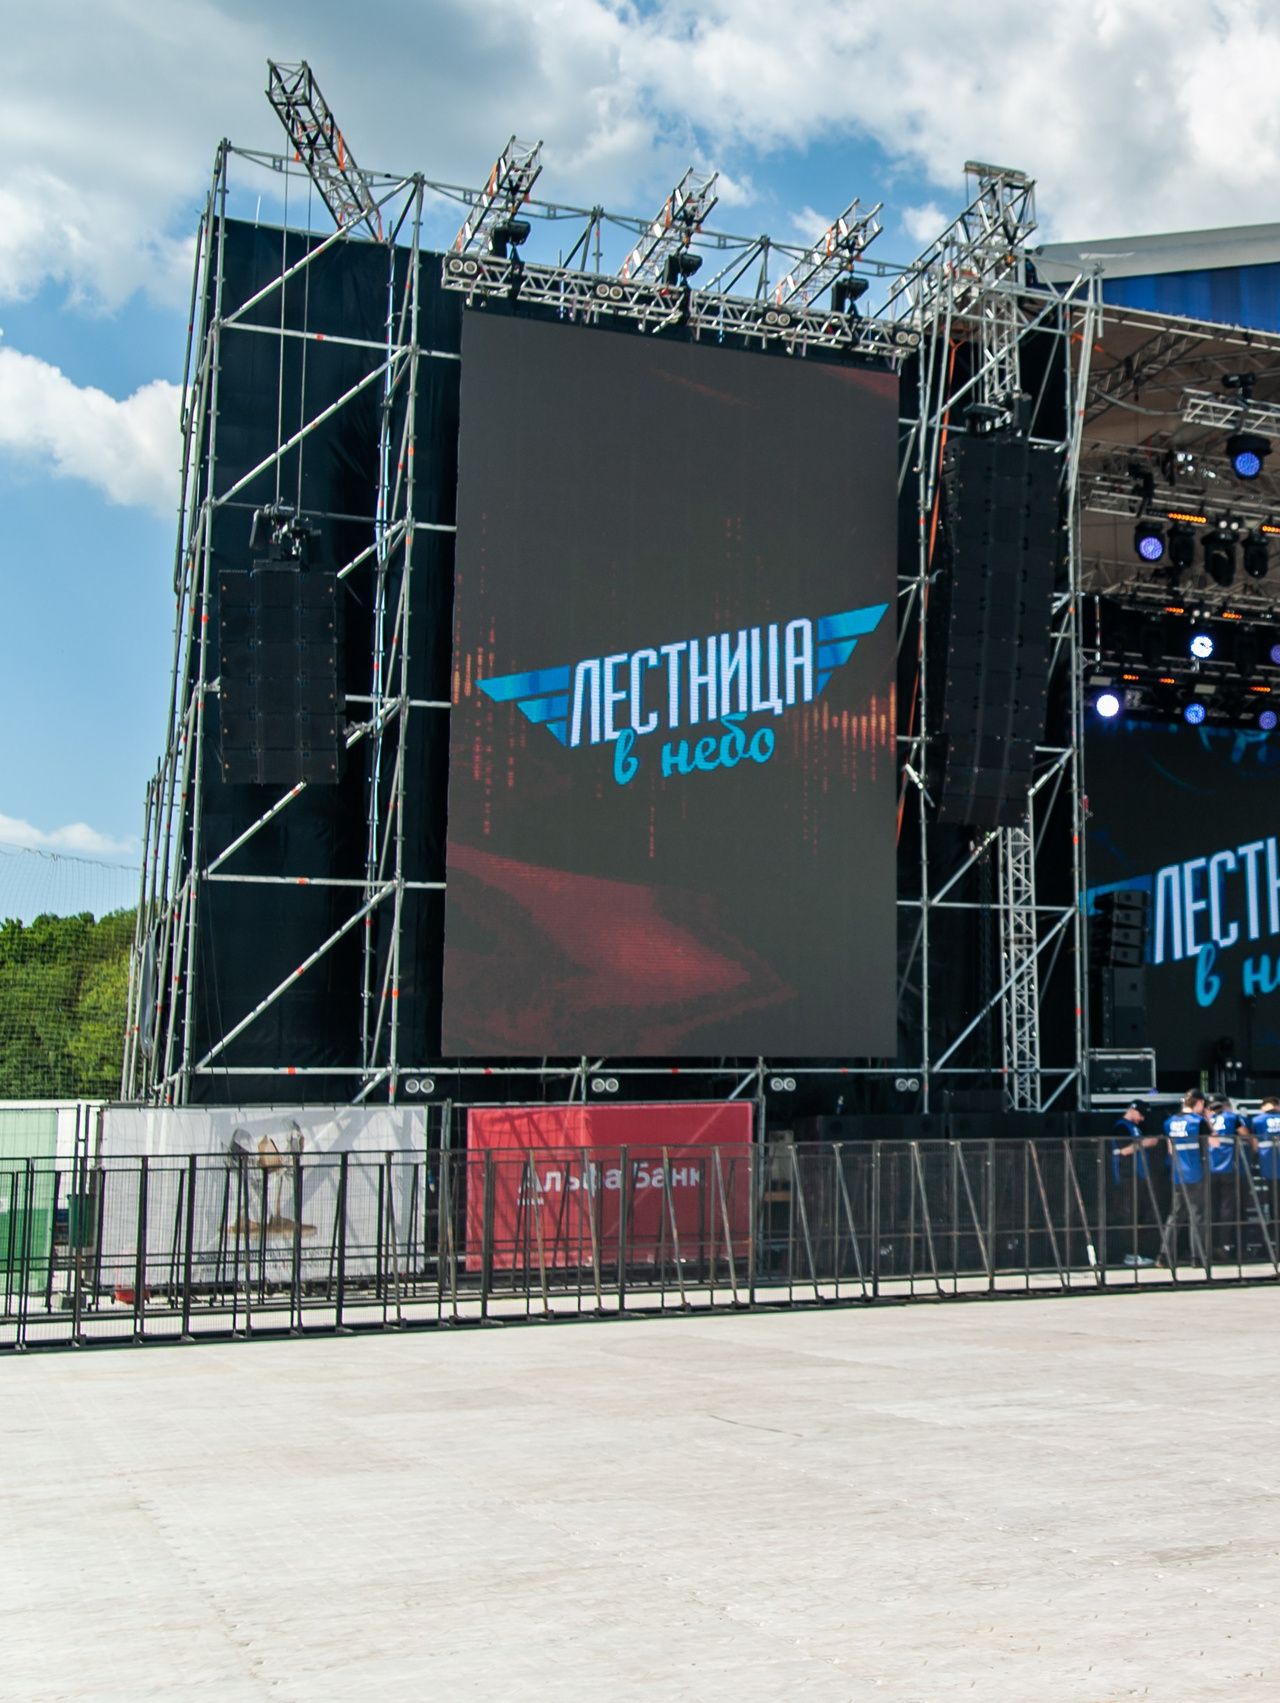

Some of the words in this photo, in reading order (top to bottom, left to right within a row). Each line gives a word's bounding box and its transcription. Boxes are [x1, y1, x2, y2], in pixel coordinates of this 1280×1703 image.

[570, 617, 813, 748] ЛЕСТНИЦА
[613, 728, 639, 786] в
[661, 712, 775, 778] небо
[1195, 942, 1221, 1007] в
